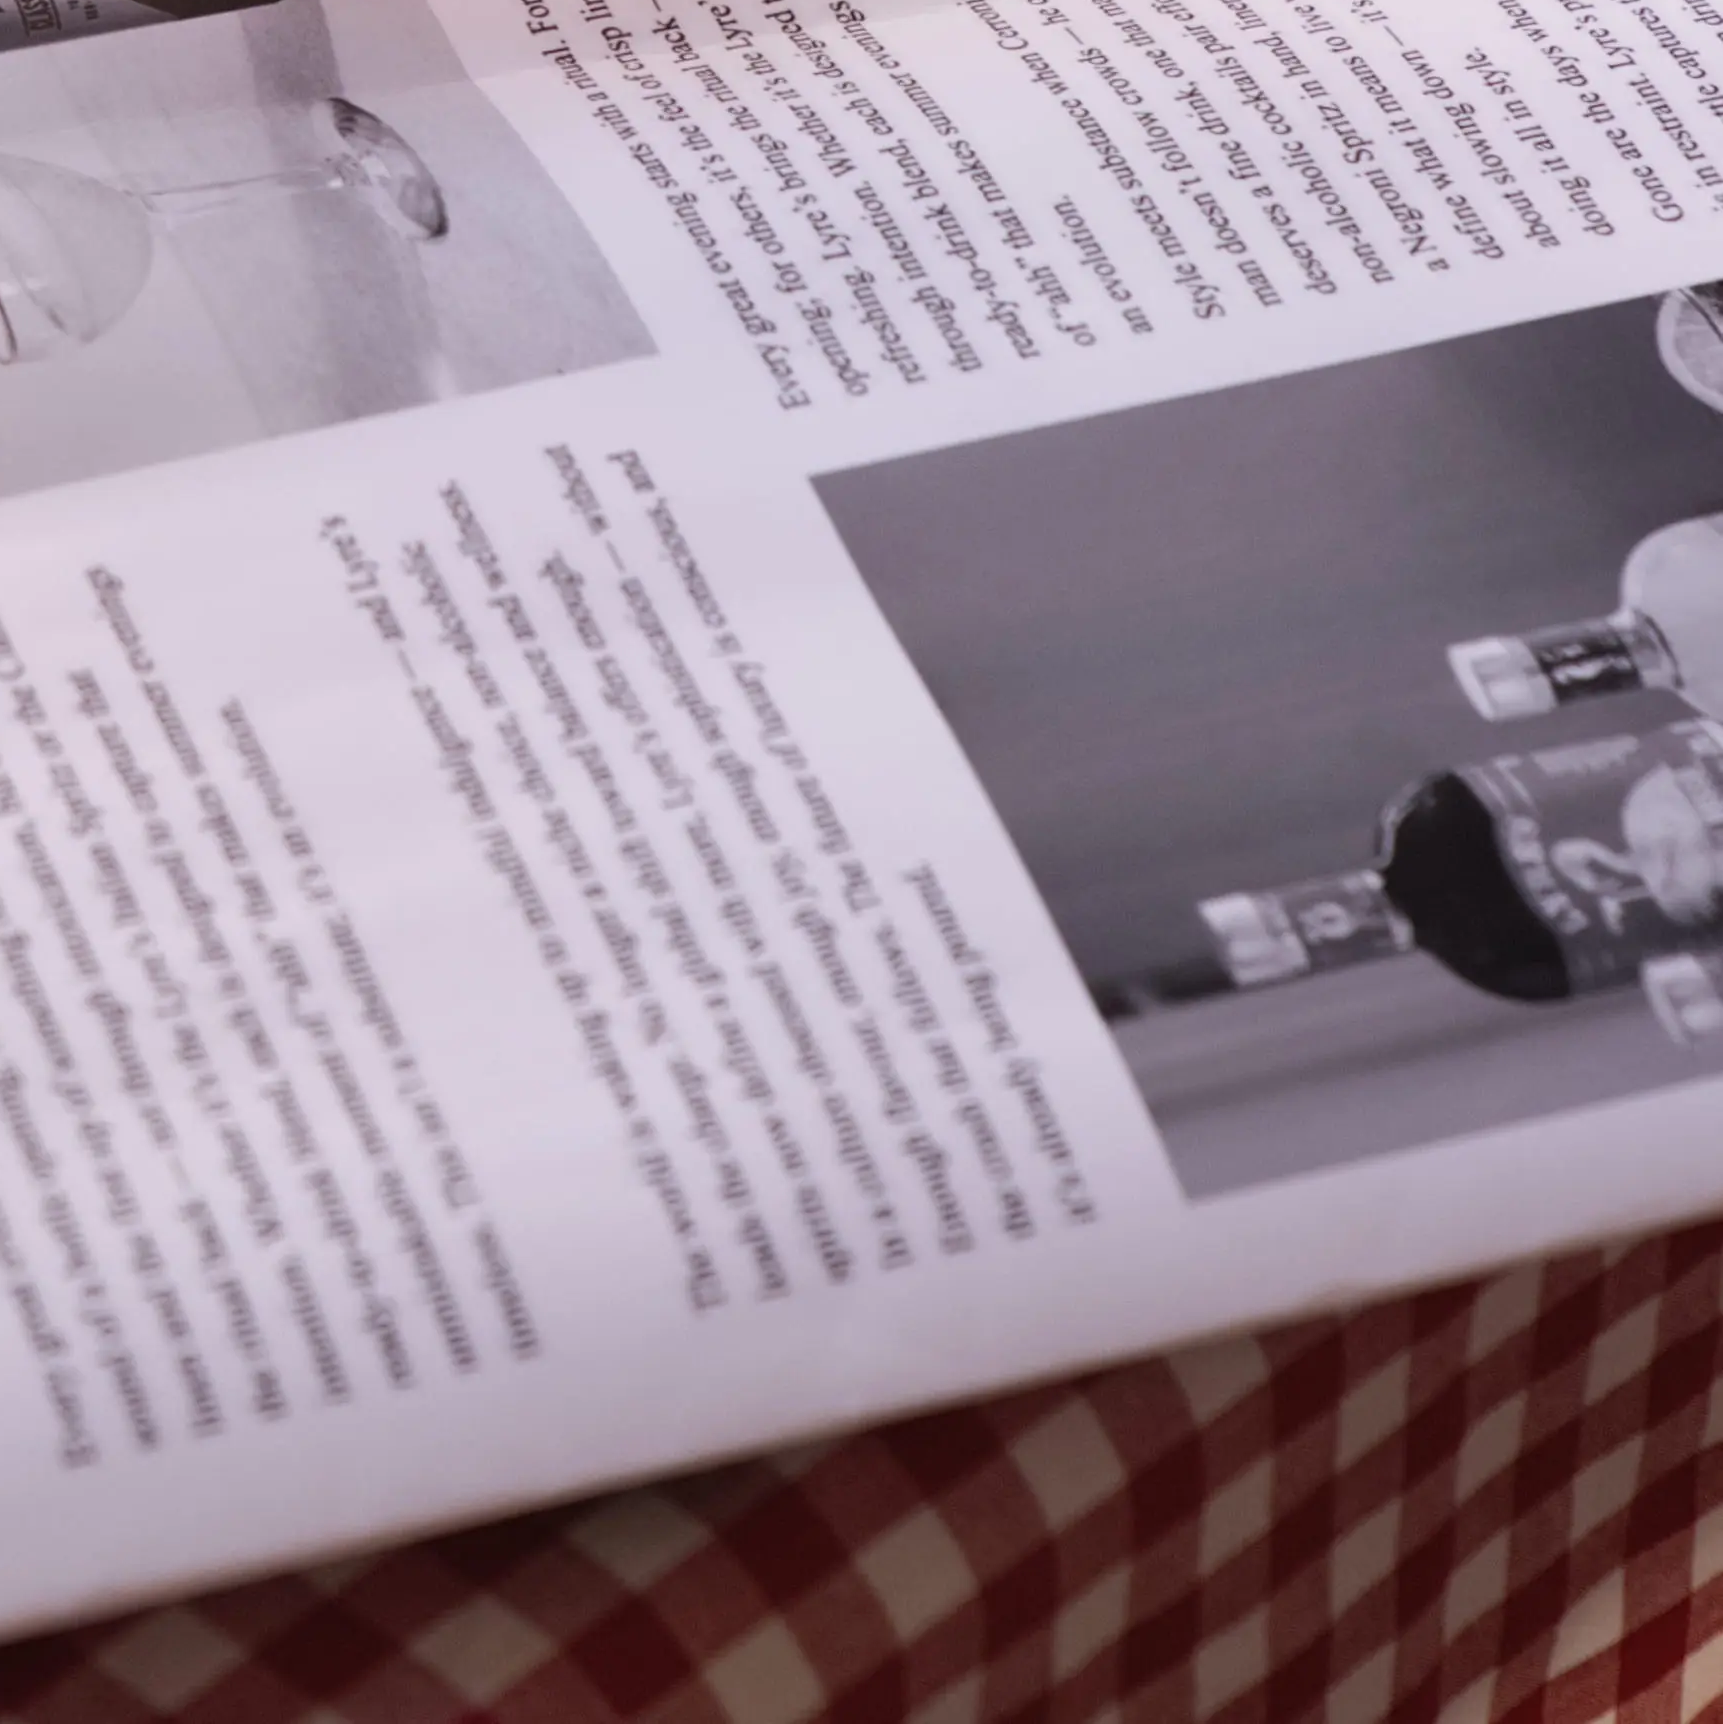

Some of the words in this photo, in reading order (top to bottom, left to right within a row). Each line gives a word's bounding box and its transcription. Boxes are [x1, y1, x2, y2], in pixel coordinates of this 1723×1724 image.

[540, 38, 599, 91] ritual.
[599, 25, 646, 72] crisp
[650, 15, 701, 65] back
[763, 7, 845, 79] designed
[828, 0, 902, 70] evenings
[680, 63, 740, 104] ritual
[1213, 55, 1294, 136] cocktails
[1463, 46, 1516, 96] style.
[591, 103, 639, 142] with
[640, 91, 692, 123] feel
[888, 72, 960, 137] summer
[1316, 101, 1376, 165] Spritz
[627, 141, 680, 190] starts
[749, 132, 808, 193] brings
[787, 103, 858, 179] Whether
[877, 137, 940, 202] blend,
[946, 138, 1008, 204] makes
[1060, 97, 1144, 191] substance
[1131, 110, 1195, 173] follow
[1443, 101, 1517, 186] slowing
[665, 191, 734, 276] evening
[729, 185, 786, 256] others,
[852, 180, 929, 281] intention.
[1128, 193, 1188, 259] meets
[1280, 140, 1396, 285] non-alcoholic
[1359, 167, 1438, 257] Negroni
[1444, 193, 1506, 261] define
[771, 260, 809, 295] for
[922, 201, 1042, 361] ready-to-drink
[1052, 194, 1134, 303] evolution.
[1261, 201, 1339, 296] deserves
[716, 277, 778, 337] great
[1172, 261, 1227, 321] Style
[795, 297, 871, 397] opening;
[842, 265, 928, 385] refreshing.
[909, 284, 984, 373] through
[756, 343, 812, 411] Every
[605, 448, 658, 495] and
[318, 514, 380, 594] Lyre's
[355, 594, 407, 643] and
[485, 592, 539, 644] and
